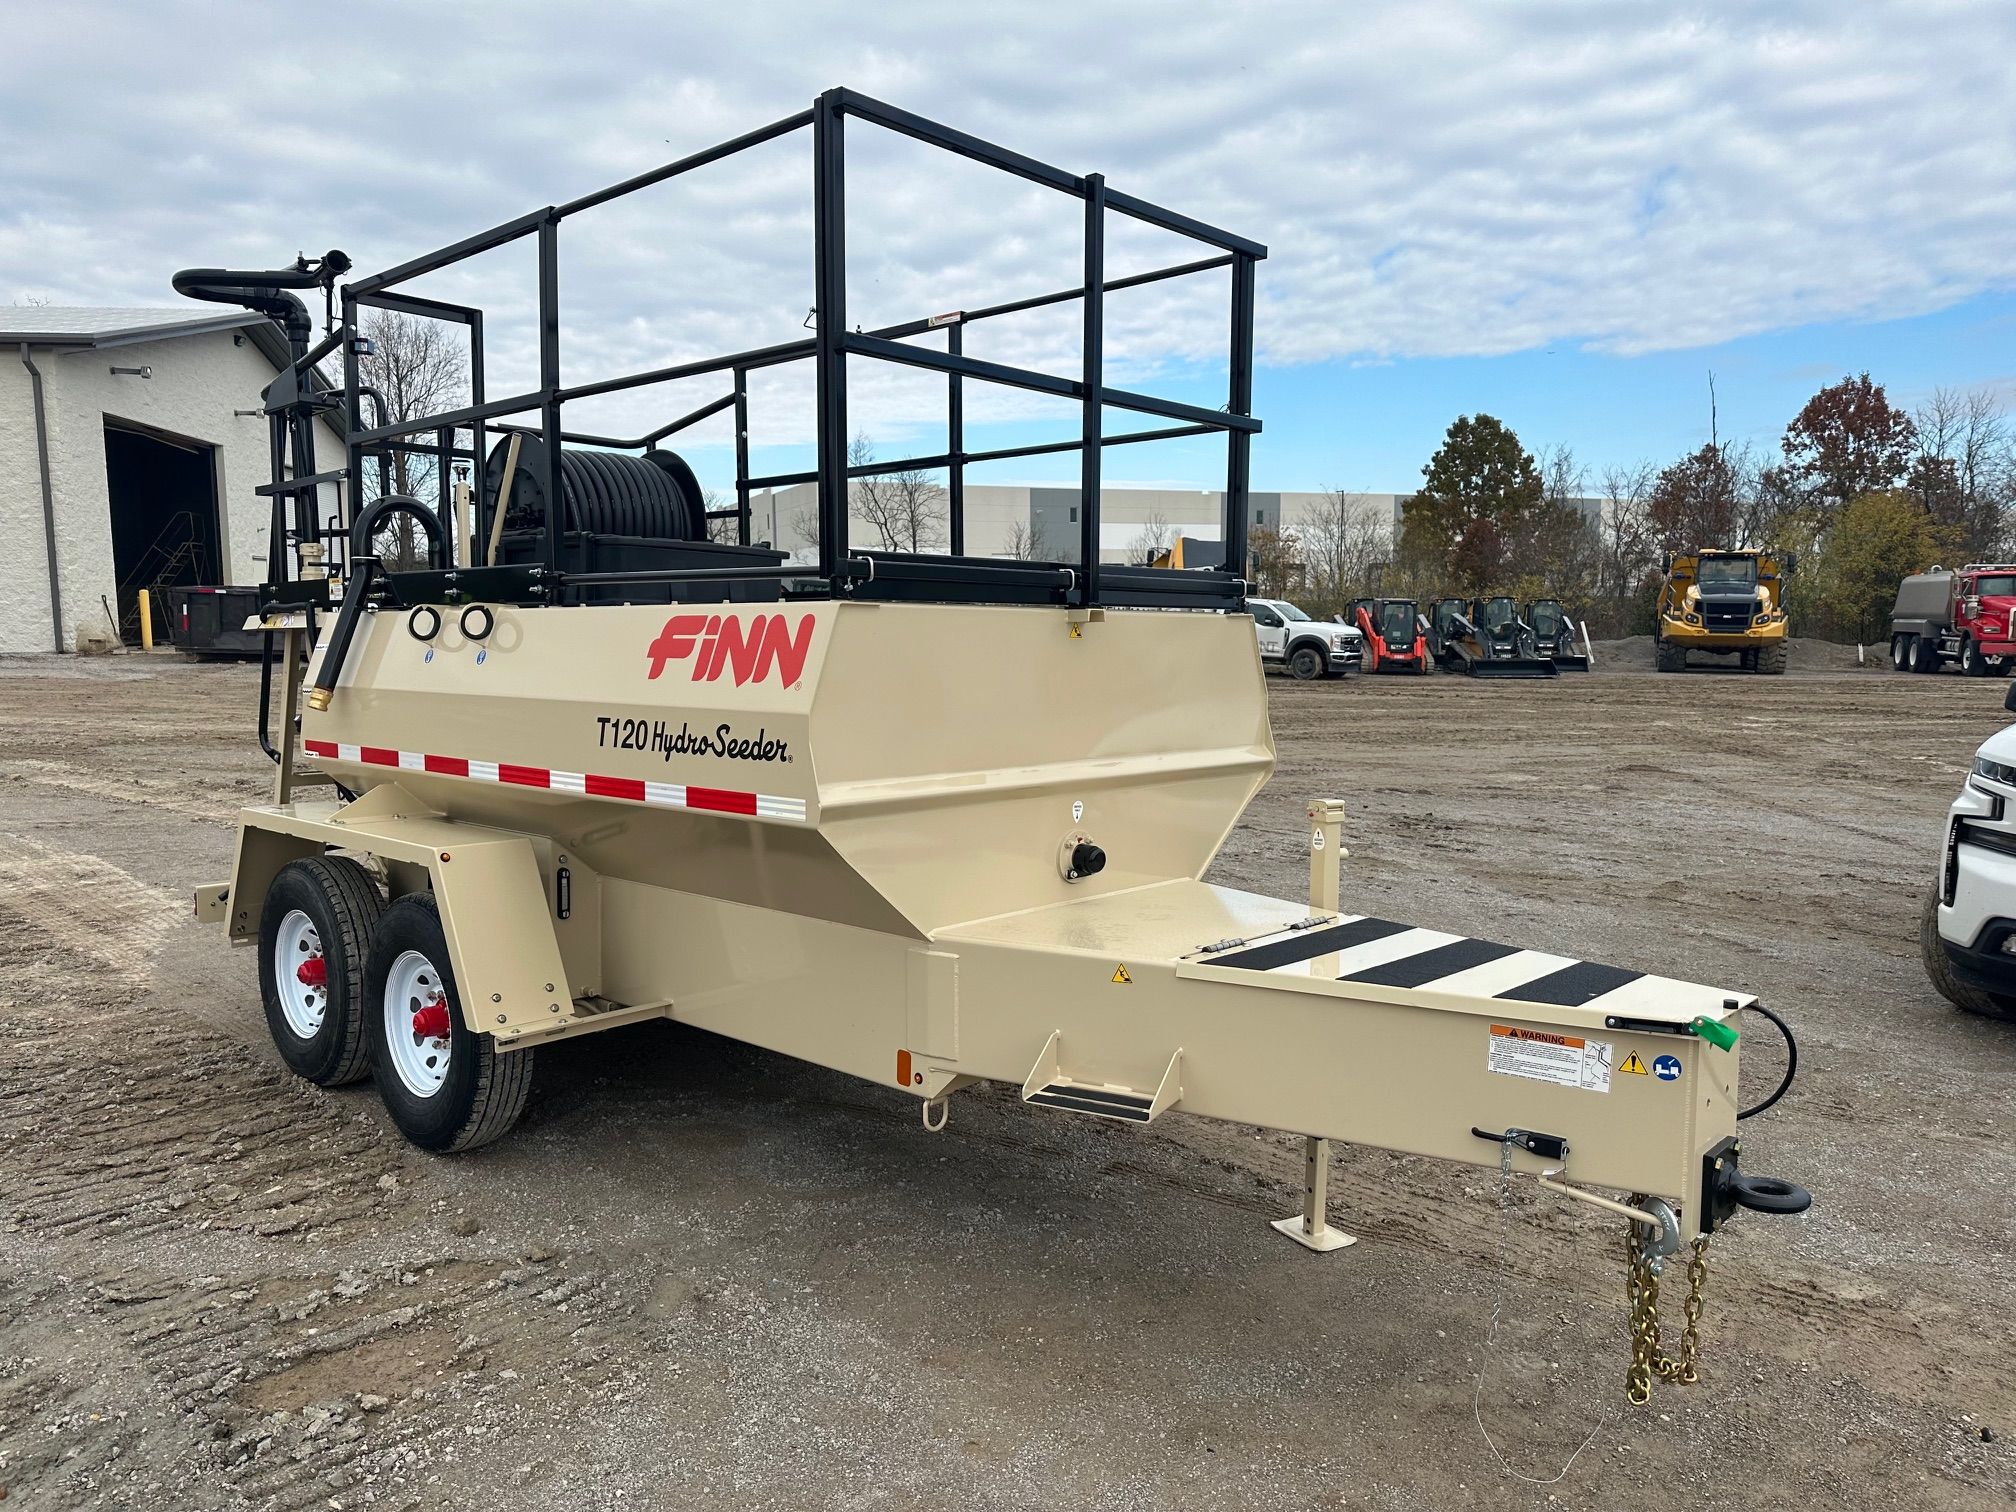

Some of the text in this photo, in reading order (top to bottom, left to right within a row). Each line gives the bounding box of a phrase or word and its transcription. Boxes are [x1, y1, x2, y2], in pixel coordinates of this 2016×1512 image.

[647, 613, 816, 690] FINN
[597, 717, 648, 751] T120
[1520, 1029, 1565, 1045] WARNING
